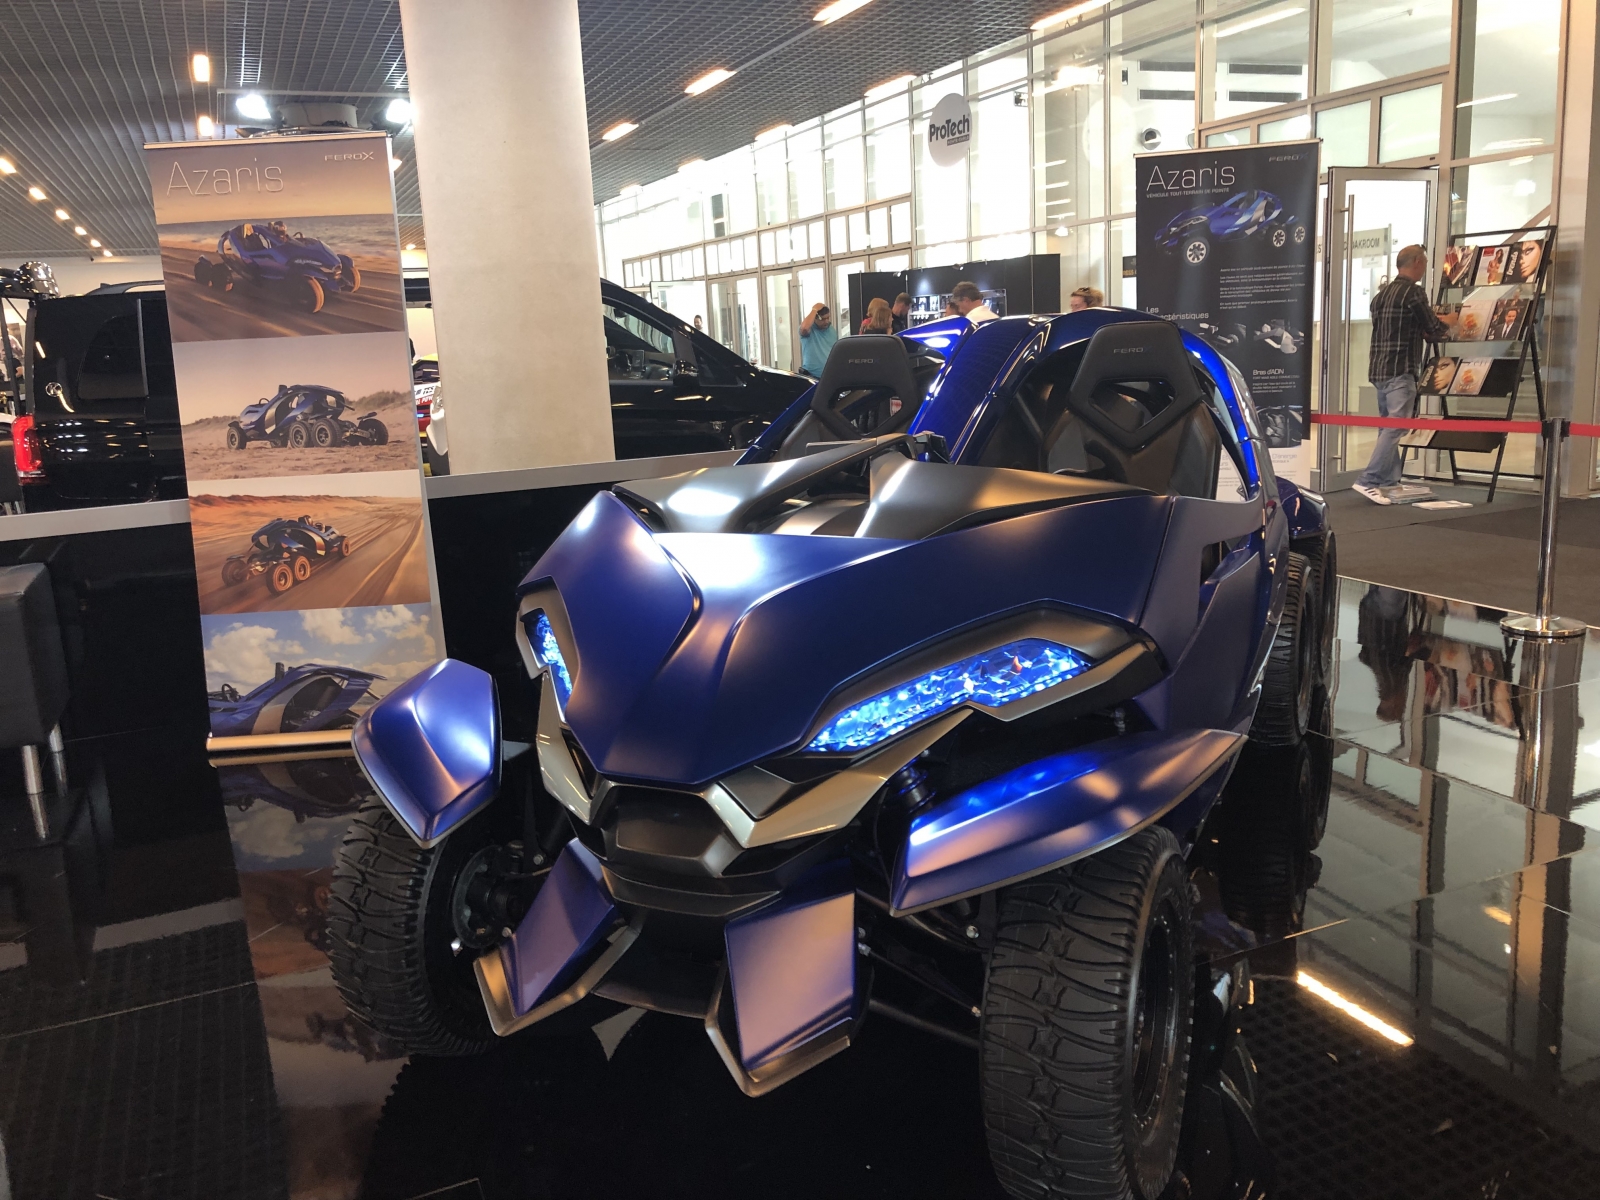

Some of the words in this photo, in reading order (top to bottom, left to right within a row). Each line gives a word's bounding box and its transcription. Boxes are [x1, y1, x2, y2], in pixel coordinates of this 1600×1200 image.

[929, 114, 970, 142] ProTech
[324, 151, 375, 161] FEROX
[166, 157, 284, 196] Azaris
[1146, 161, 1235, 191] Azaris
[1146, 306, 1159, 314] Les
